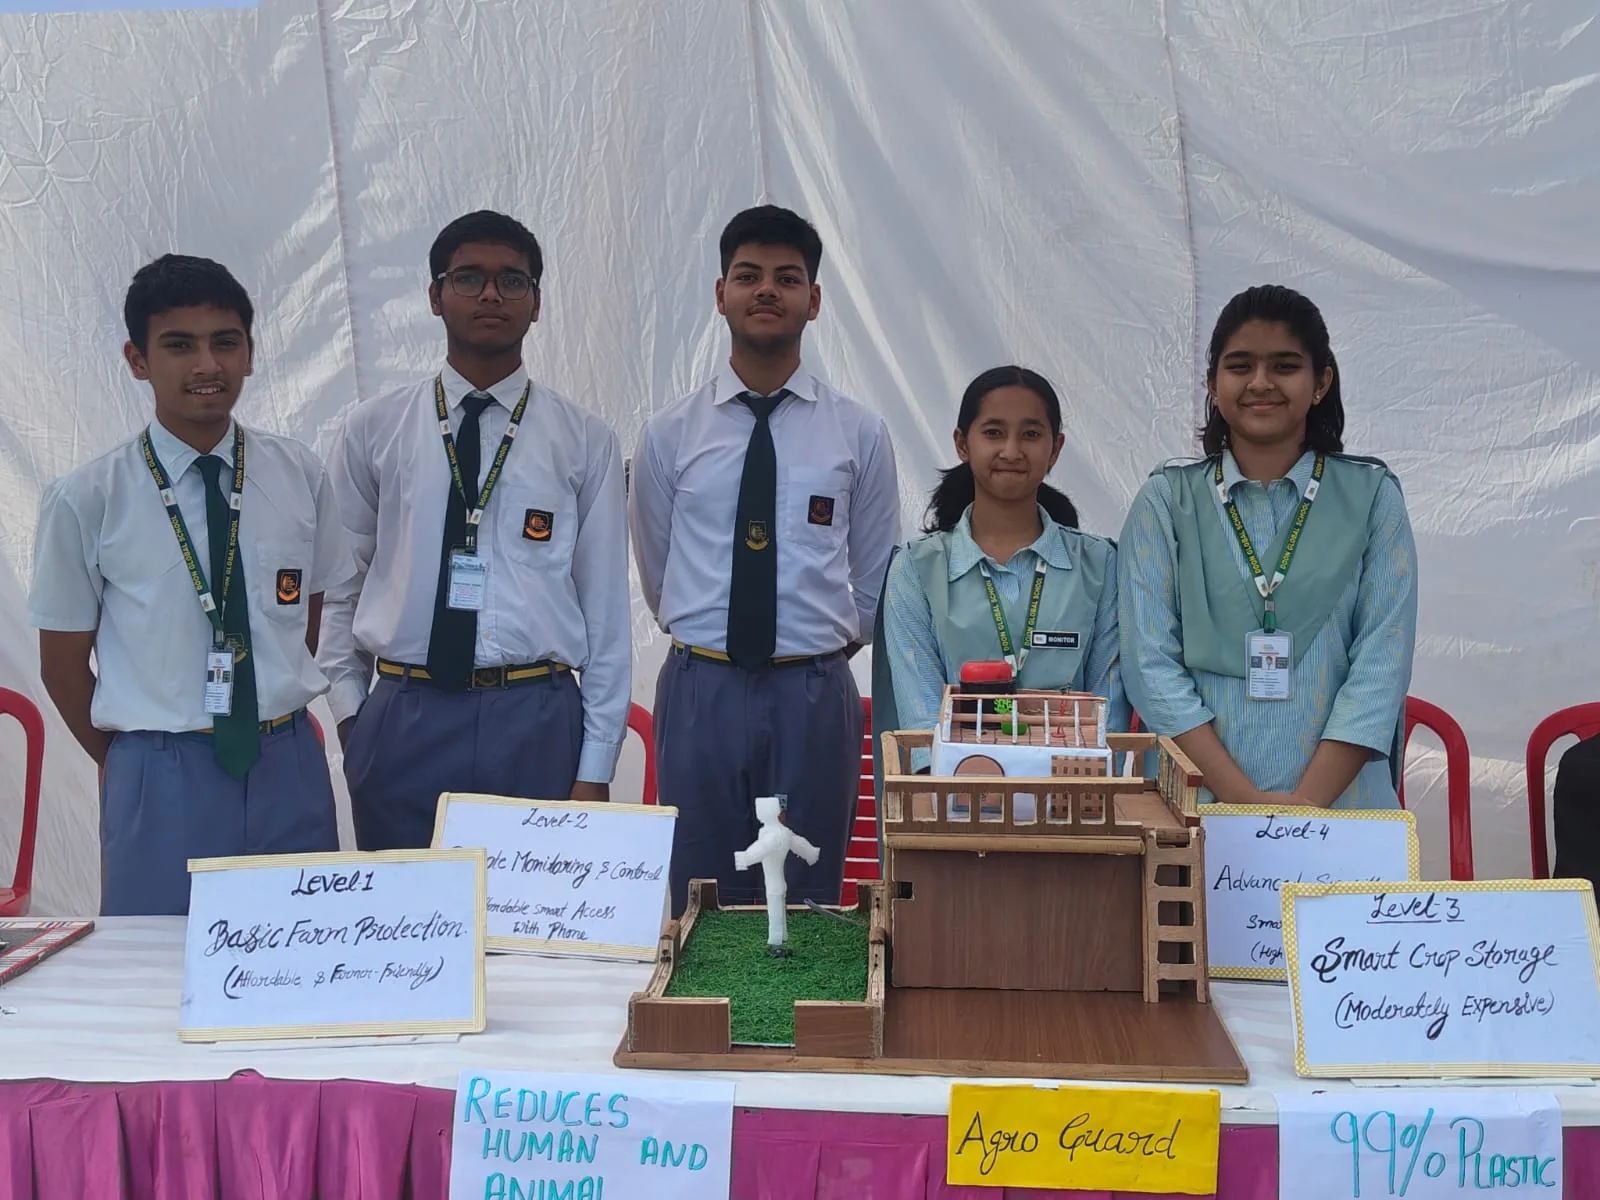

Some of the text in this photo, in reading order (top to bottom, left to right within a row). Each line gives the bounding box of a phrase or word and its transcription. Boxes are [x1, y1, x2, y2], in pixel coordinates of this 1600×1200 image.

[235, 470, 243, 488] DOON
[479, 443, 508, 507] DOON GLOBAL SCHOOL
[228, 519, 239, 546] SCHOOL
[1228, 505, 1260, 574] DOON GLOBAL SCHOOL
[1280, 501, 1309, 570] DOON GLOBAL SCHOOL
[169, 514, 202, 591] DOON GLOBAL SCHOOL
[224, 548, 234, 574] GLOBAL
[986, 579, 1009, 651] DOON GLOBAL SCHOOL
[1028, 600, 1038, 625] GLOBAL
[1033, 577, 1043, 600] SCHOOL
[1048, 636, 1075, 644] MONITOR
[522, 808, 588, 829] Level-2
[1256, 815, 1329, 840] Level-4
[291, 869, 374, 896] Level-1
[511, 851, 593, 888] Monitoring
[610, 861, 663, 881] Control
[1213, 865, 1303, 892] Advanc
[571, 900, 615, 920] Access
[1246, 914, 1284, 929] Sma
[205, 919, 284, 956] Basic
[285, 919, 348, 948] Farm
[546, 921, 589, 943] Phone
[1310, 937, 1559, 984] Smart Crop Storage
[1335, 991, 1449, 1040] (Moderately
[464, 1076, 630, 1129] REDUCES
[482, 1127, 708, 1170] HUMAN AND
[955, 1111, 1181, 1175] Agro Guard
[1331, 1108, 1556, 1197] 99% PLASTIC
